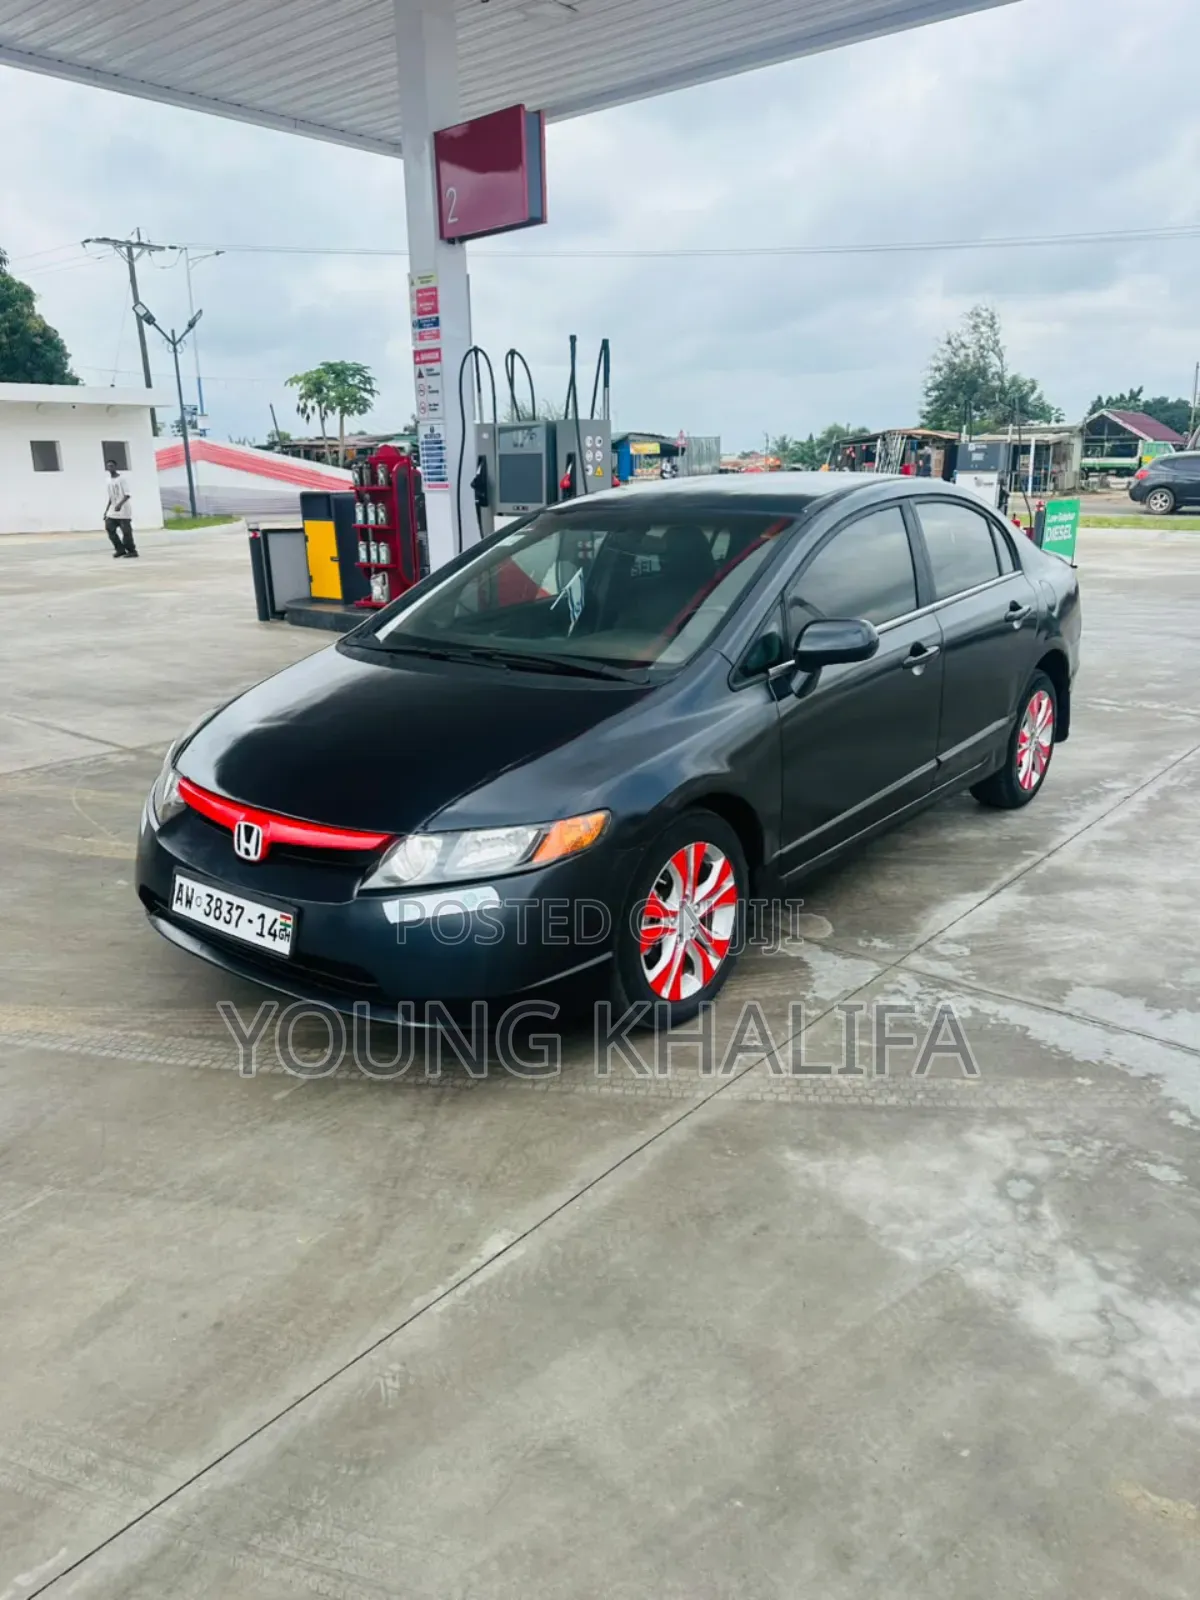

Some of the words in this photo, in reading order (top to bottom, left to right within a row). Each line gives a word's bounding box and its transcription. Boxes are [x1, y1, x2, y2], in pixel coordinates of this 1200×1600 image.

[445, 187, 459, 224] 2
[1045, 524, 1073, 542] DIESEL
[175, 883, 195, 909] AW
[278, 927, 291, 943] GH
